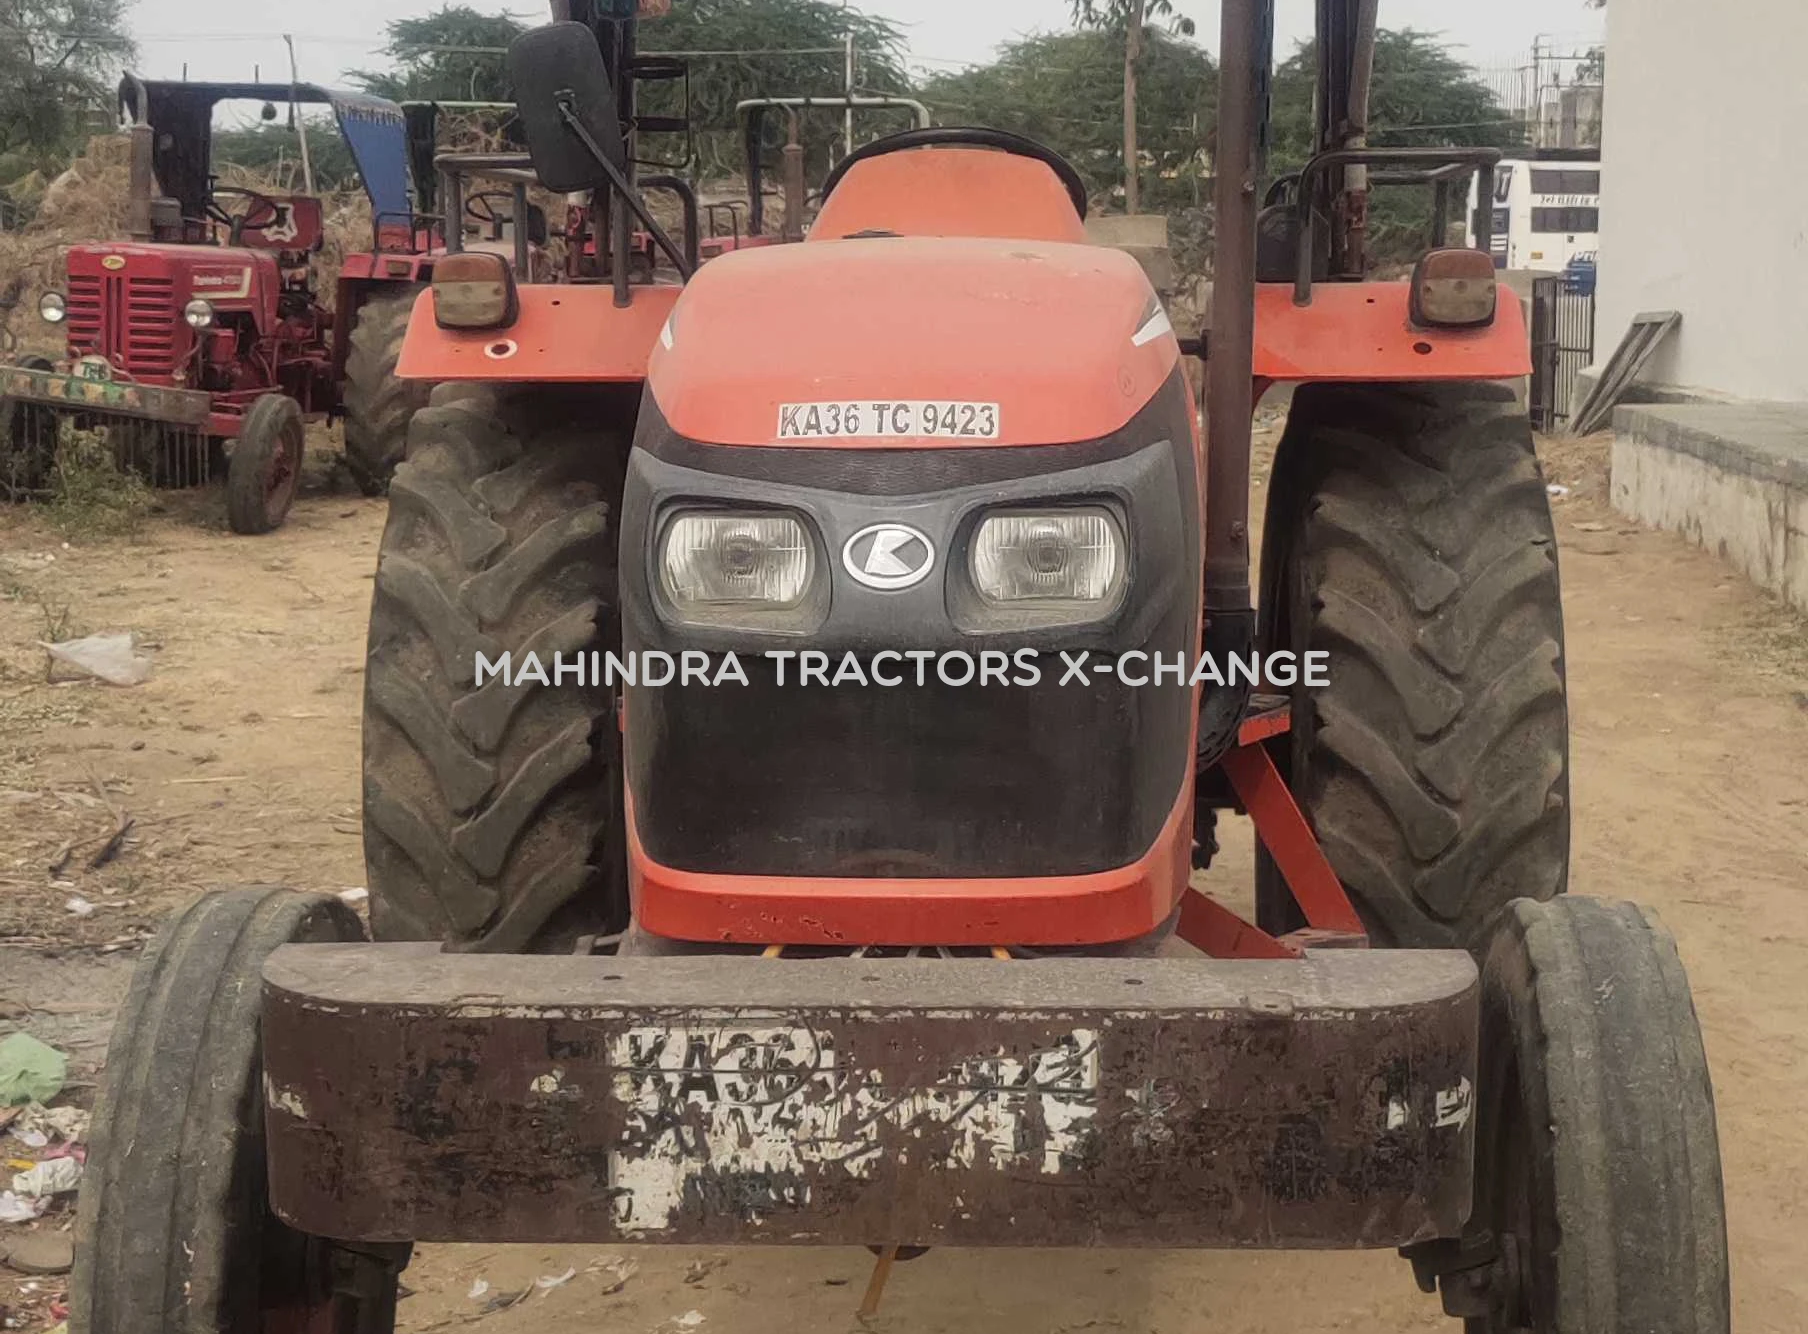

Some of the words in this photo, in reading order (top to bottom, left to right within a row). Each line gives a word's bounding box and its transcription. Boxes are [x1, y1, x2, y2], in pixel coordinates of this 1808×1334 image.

[780, 403, 861, 436] KA36
[872, 403, 911, 433] TC
[922, 404, 995, 436] 9423
